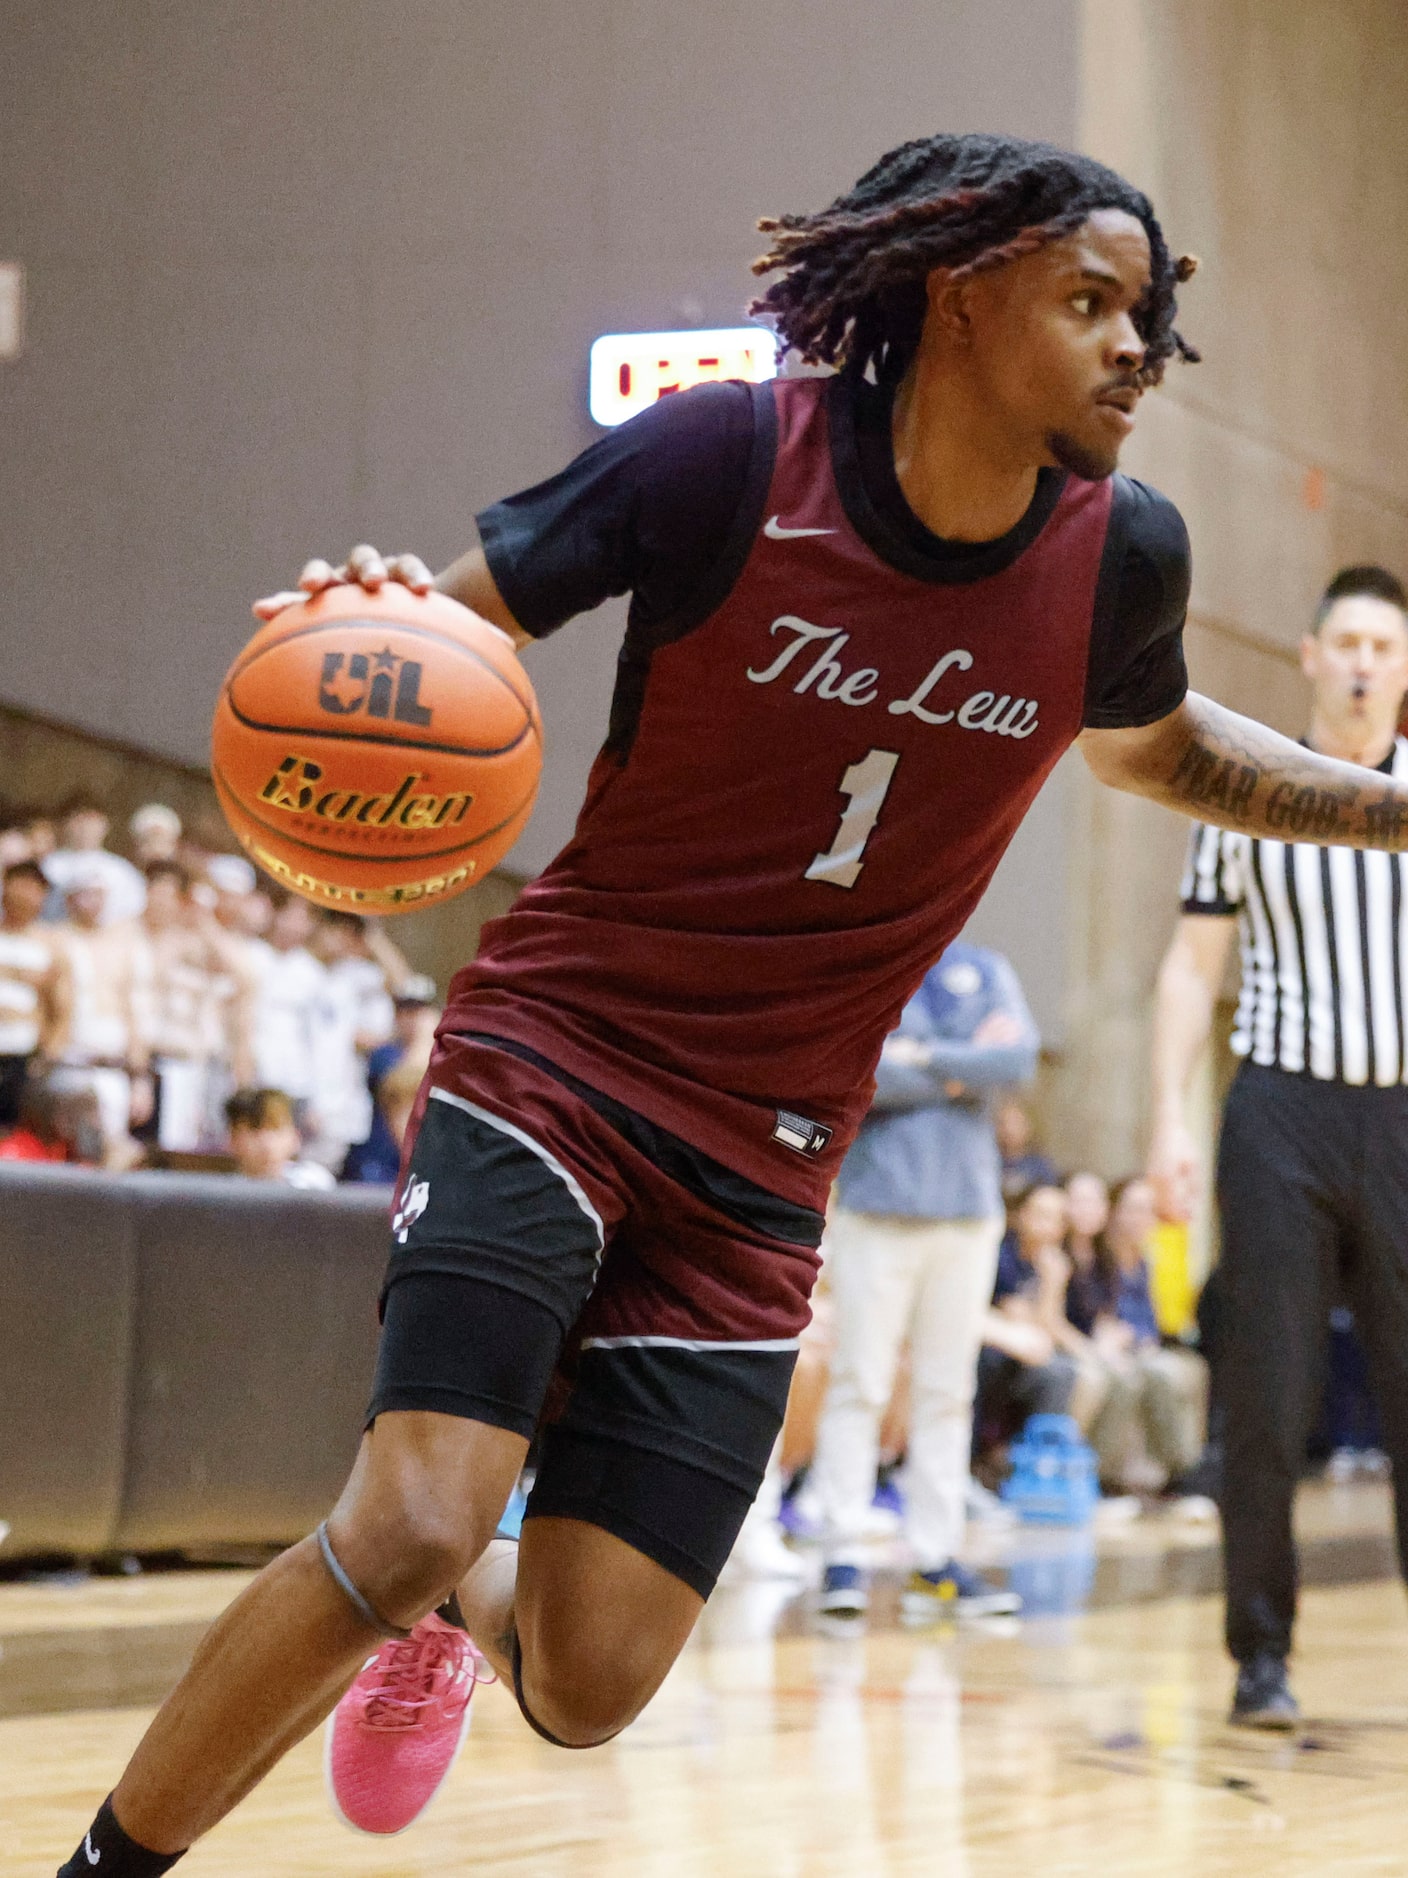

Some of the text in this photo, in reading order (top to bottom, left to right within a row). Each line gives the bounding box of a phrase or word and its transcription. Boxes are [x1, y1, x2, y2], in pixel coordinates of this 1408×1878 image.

[747, 614, 1040, 740] The Lew
[257, 752, 474, 830] Baden
[804, 748, 901, 888] 1
[811, 1134, 826, 1152] M
